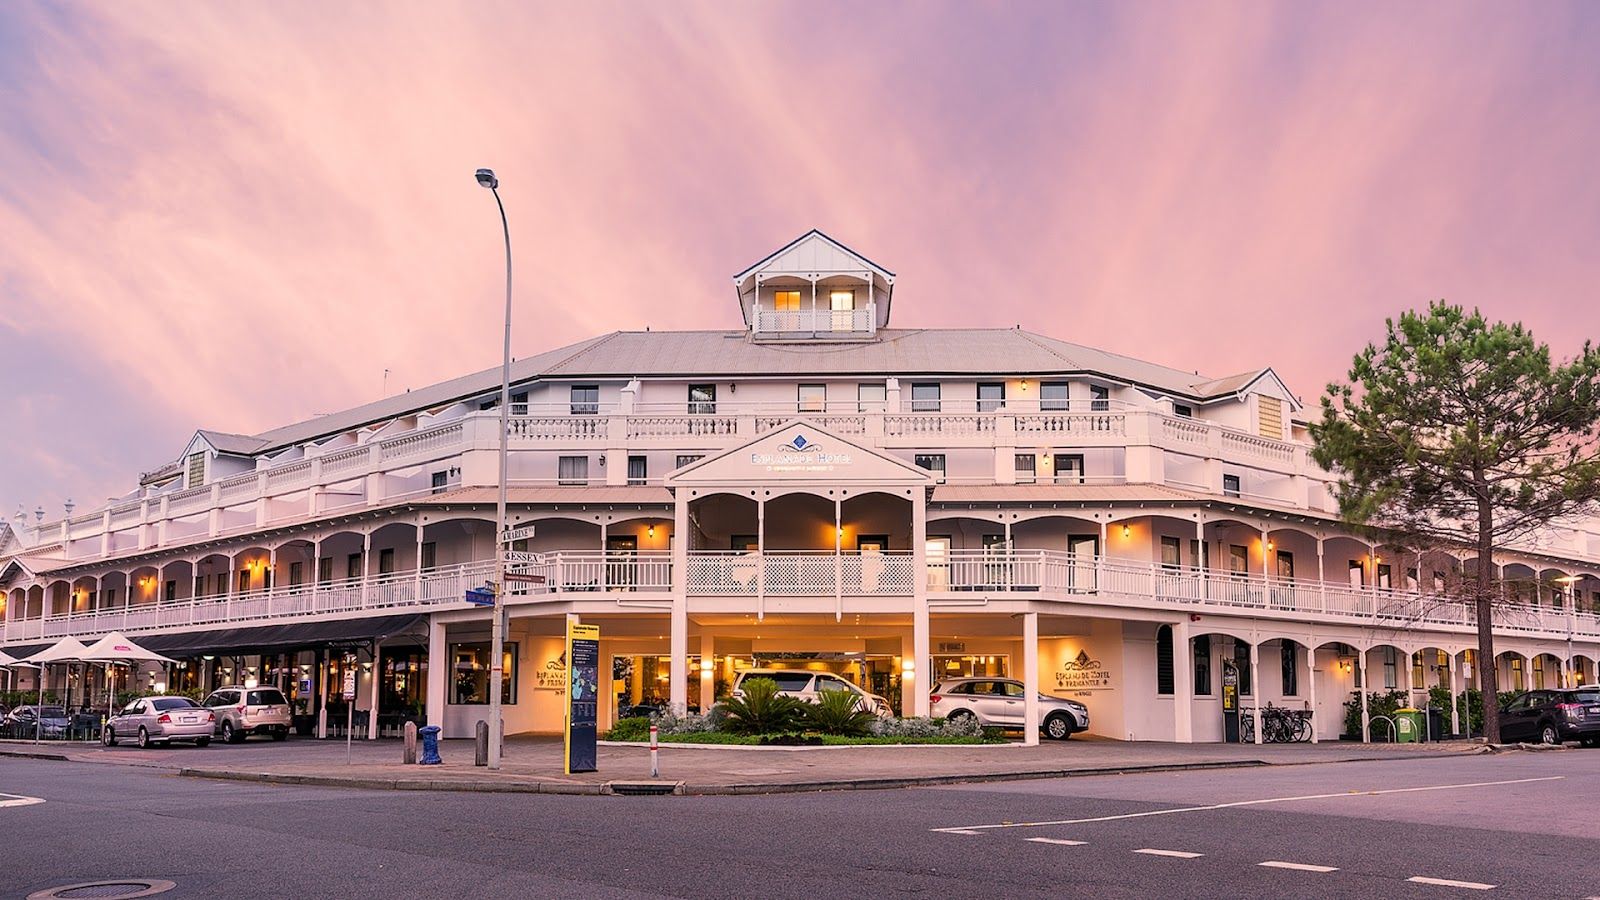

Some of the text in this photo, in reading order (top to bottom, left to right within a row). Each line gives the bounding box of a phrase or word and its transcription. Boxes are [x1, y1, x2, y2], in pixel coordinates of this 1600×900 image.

[506, 528, 528, 540] MARINE
[511, 552, 538, 563] ESSEX
[536, 671, 566, 679] ESPLANA
